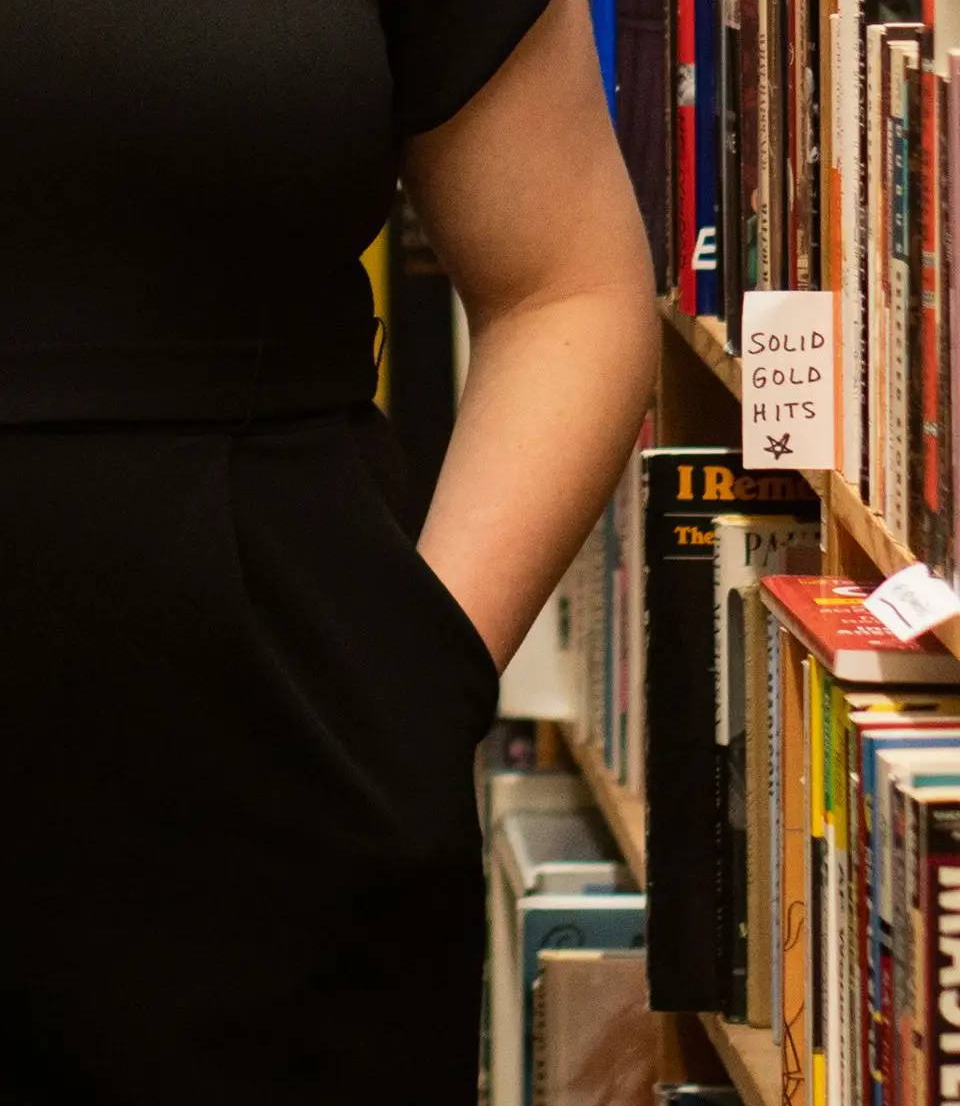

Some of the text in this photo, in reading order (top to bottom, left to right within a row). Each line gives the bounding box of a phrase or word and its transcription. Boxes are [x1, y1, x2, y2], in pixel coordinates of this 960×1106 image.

[747, 330, 825, 355] SOLID
[752, 366, 822, 389] GOLD
[753, 401, 817, 423] HITS
[676, 465, 694, 500] I
